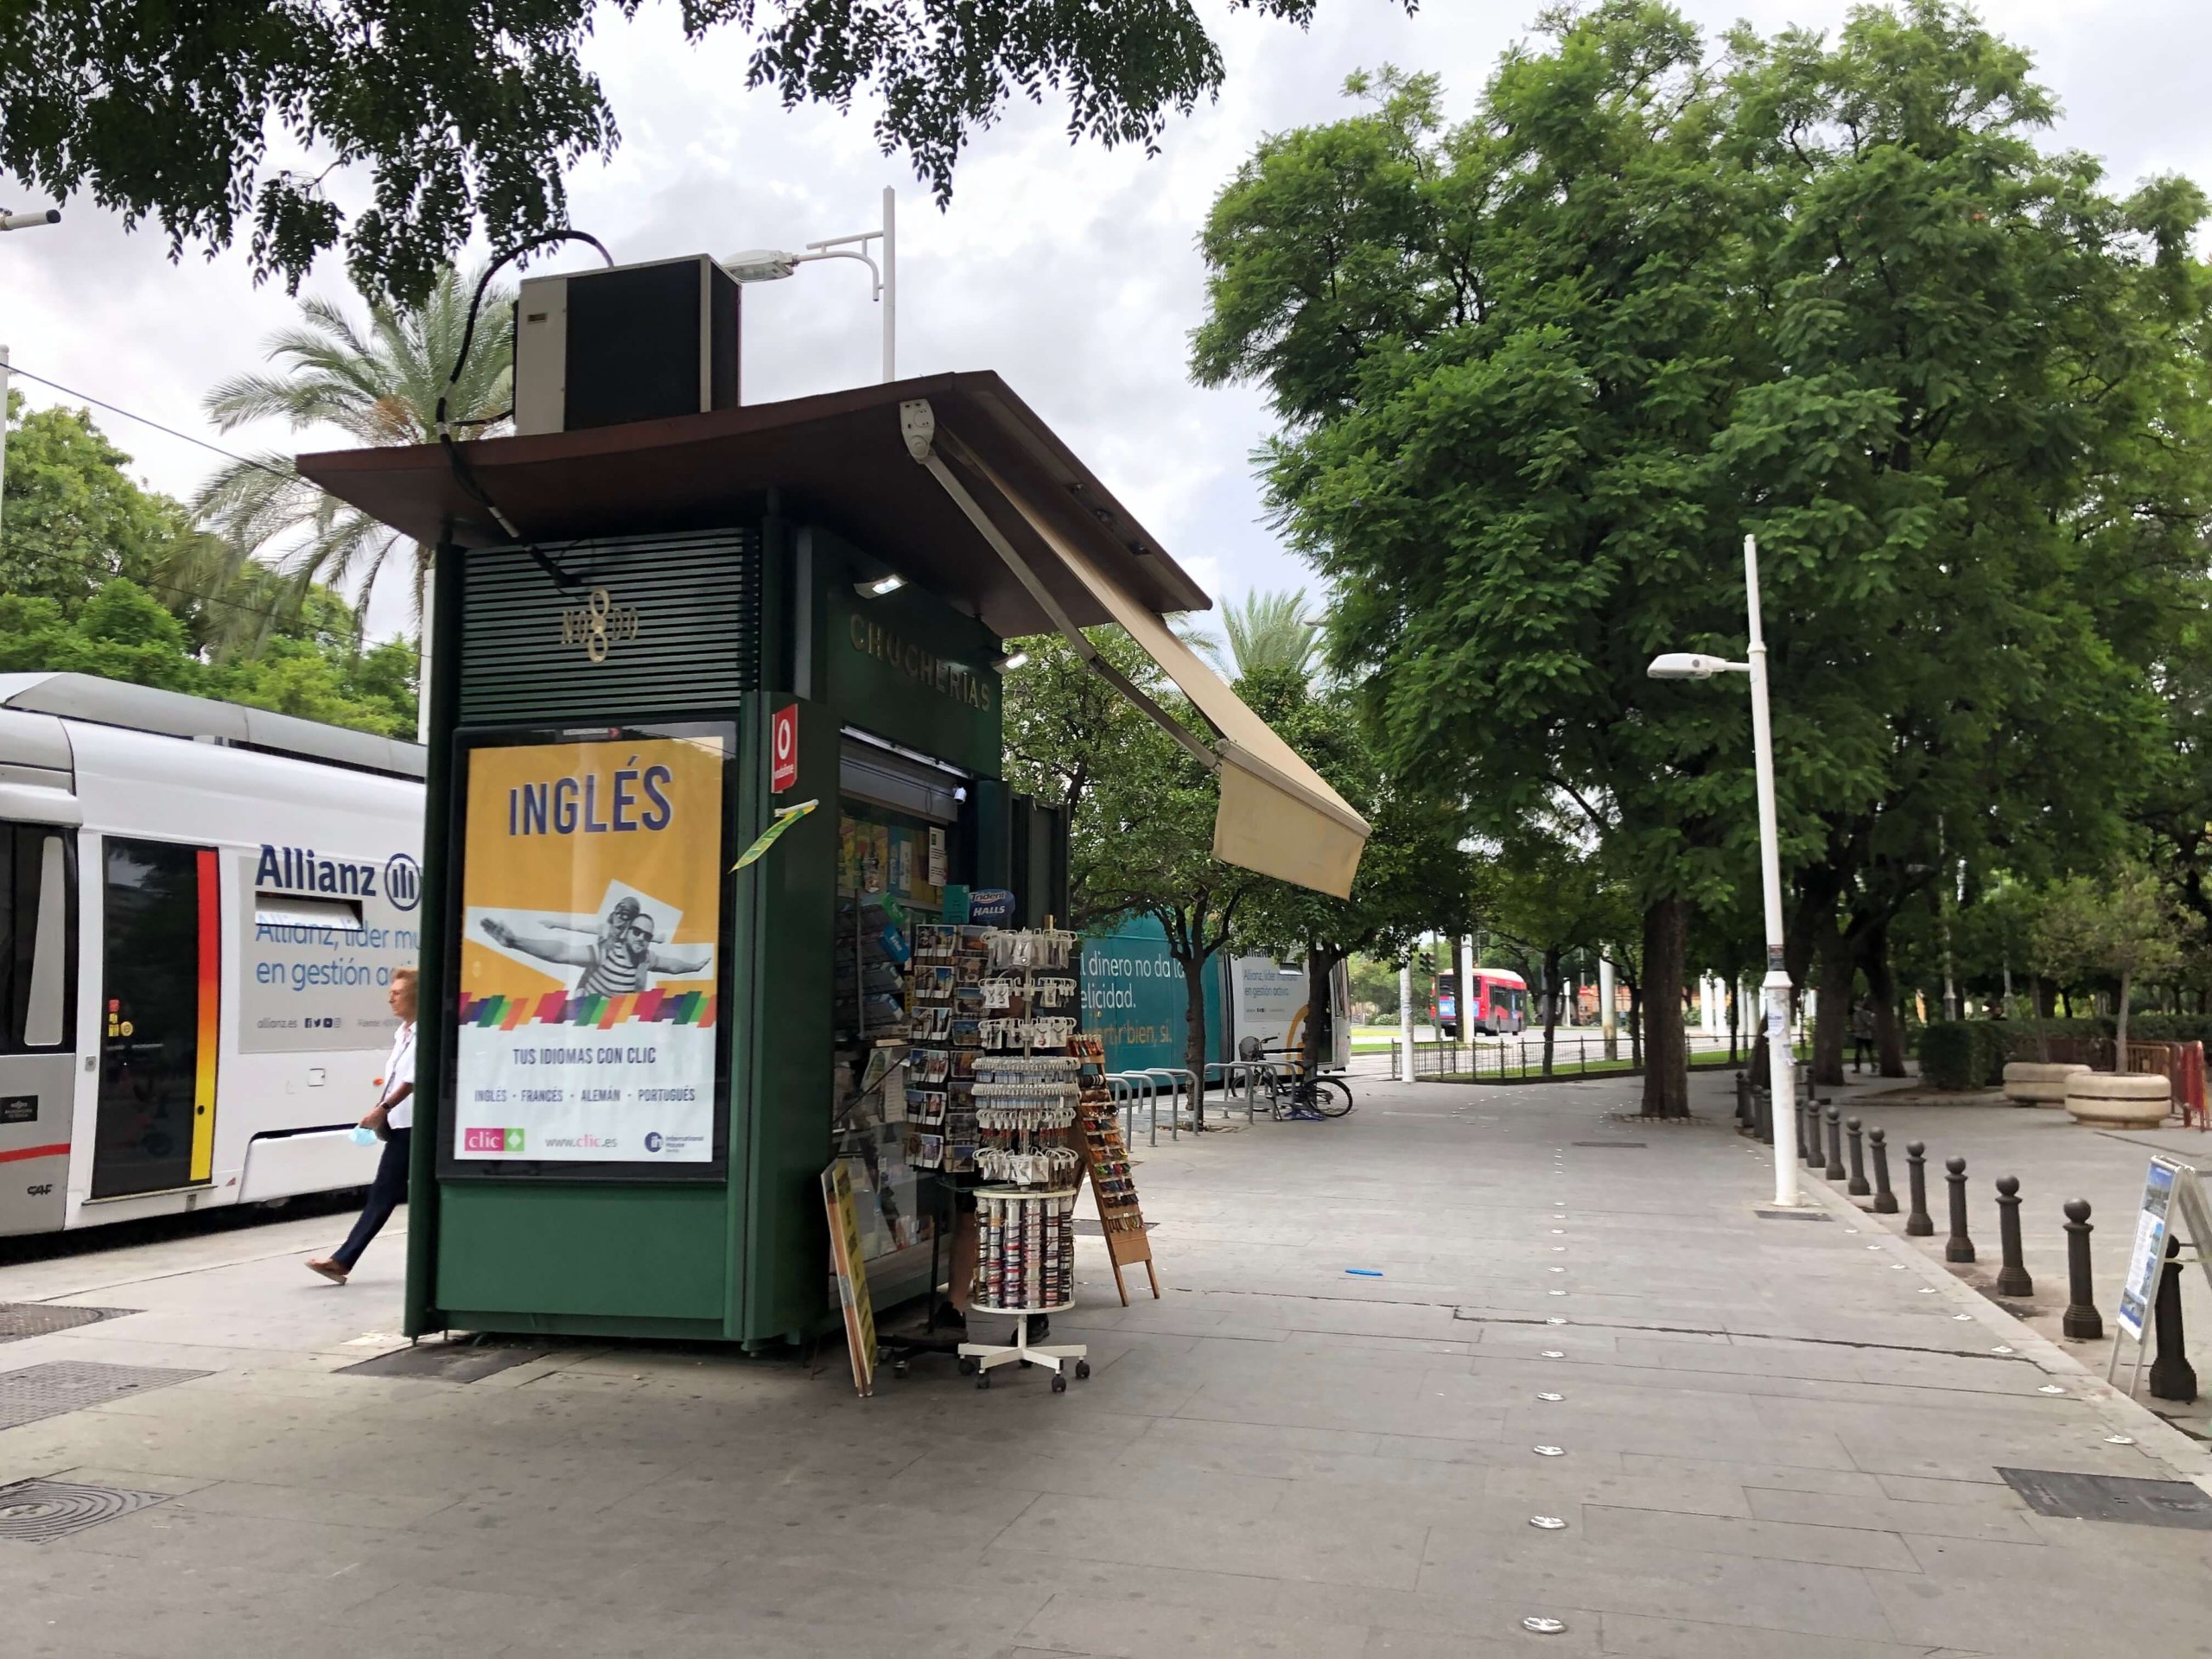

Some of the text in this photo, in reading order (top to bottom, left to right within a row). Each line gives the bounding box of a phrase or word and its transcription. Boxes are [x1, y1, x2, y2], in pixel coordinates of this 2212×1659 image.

[509, 754, 673, 836] INGLÉS
[255, 844, 377, 897] Allianz
[969, 891, 1007, 903] Trident
[973, 906, 1006, 917] HALLS
[256, 961, 286, 984] en
[290, 957, 371, 991] gestión
[1089, 950, 1133, 978] dinero
[1135, 958, 1152, 978] no
[1154, 953, 1172, 978] da
[1080, 982, 1137, 1009] elicidad.
[1127, 1020, 1158, 1046] bien,
[512, 1046, 657, 1065] TUS IDIOMAS CON CLIC
[474, 1085, 696, 1103] INGLÉS FRANCÉS ALEMÁN PORTUGUÉS
[468, 1129, 500, 1148] clic
[545, 1134, 618, 1148] www.clic.es
